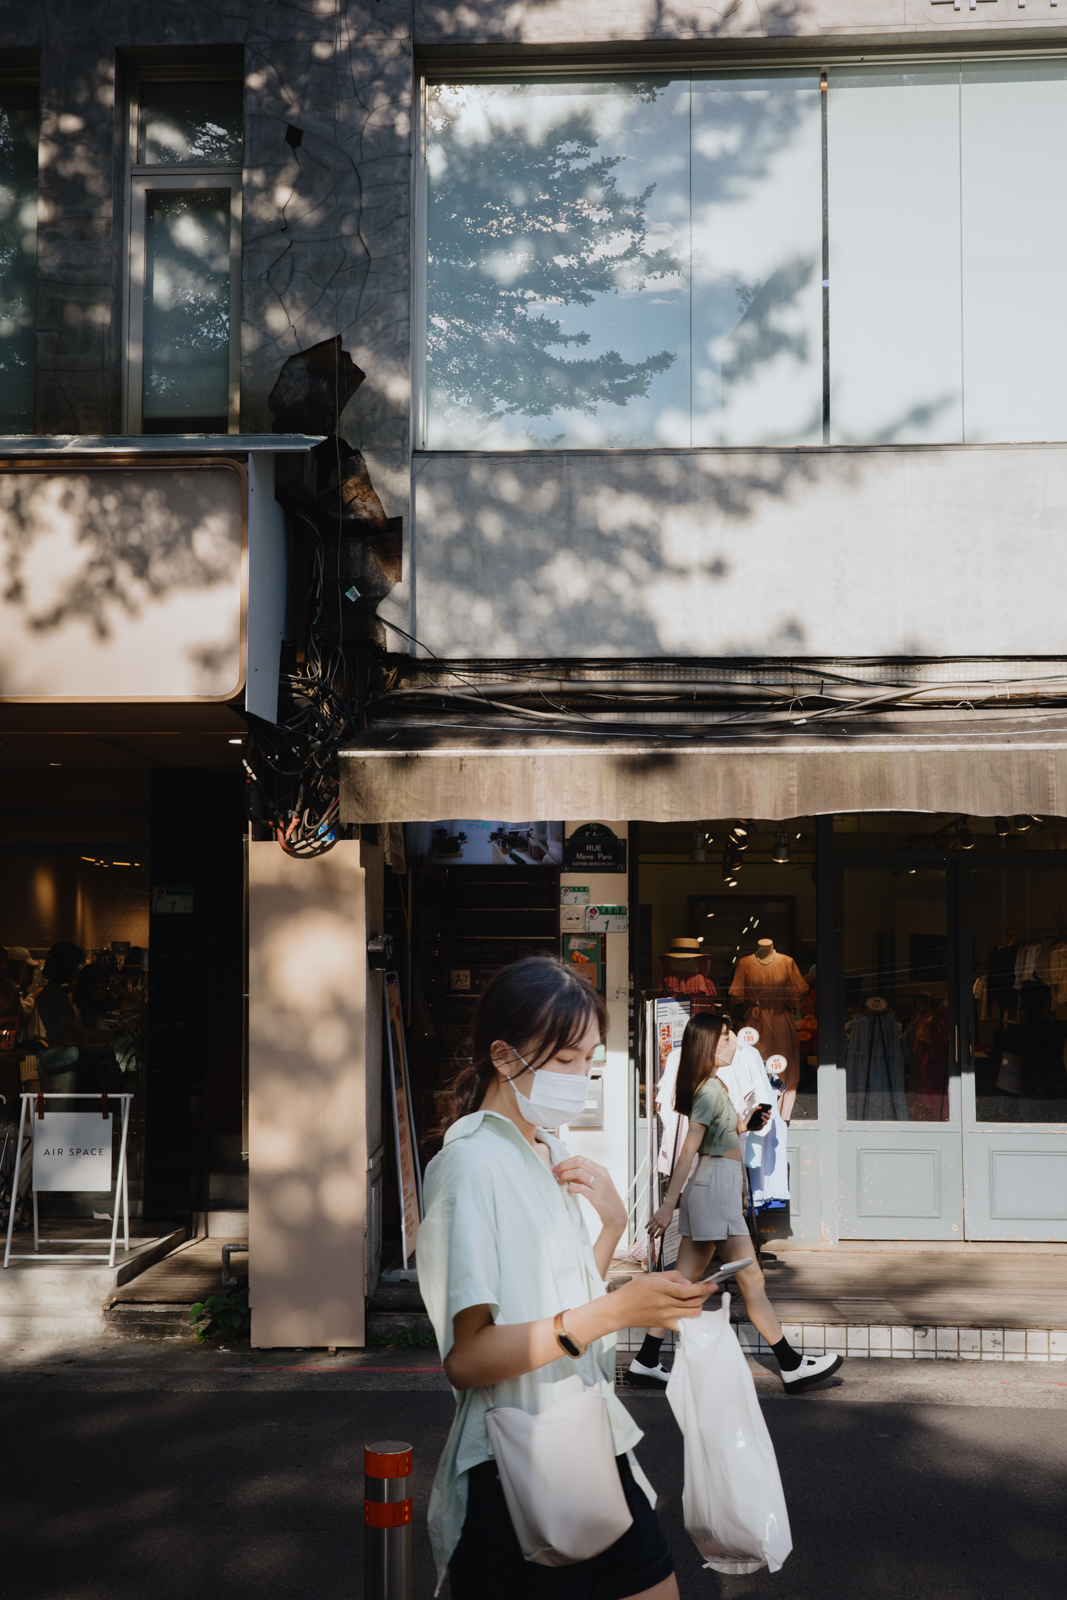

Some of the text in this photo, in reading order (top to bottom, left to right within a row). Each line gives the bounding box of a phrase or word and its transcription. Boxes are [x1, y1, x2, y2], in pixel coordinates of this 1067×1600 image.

[586, 844, 602, 852] RUE
[597, 852, 613, 860] Paris
[604, 919, 610, 931] 1
[771, 1062, 782, 1070] 199
[43, 1148, 104, 1156] AIR SPACE
